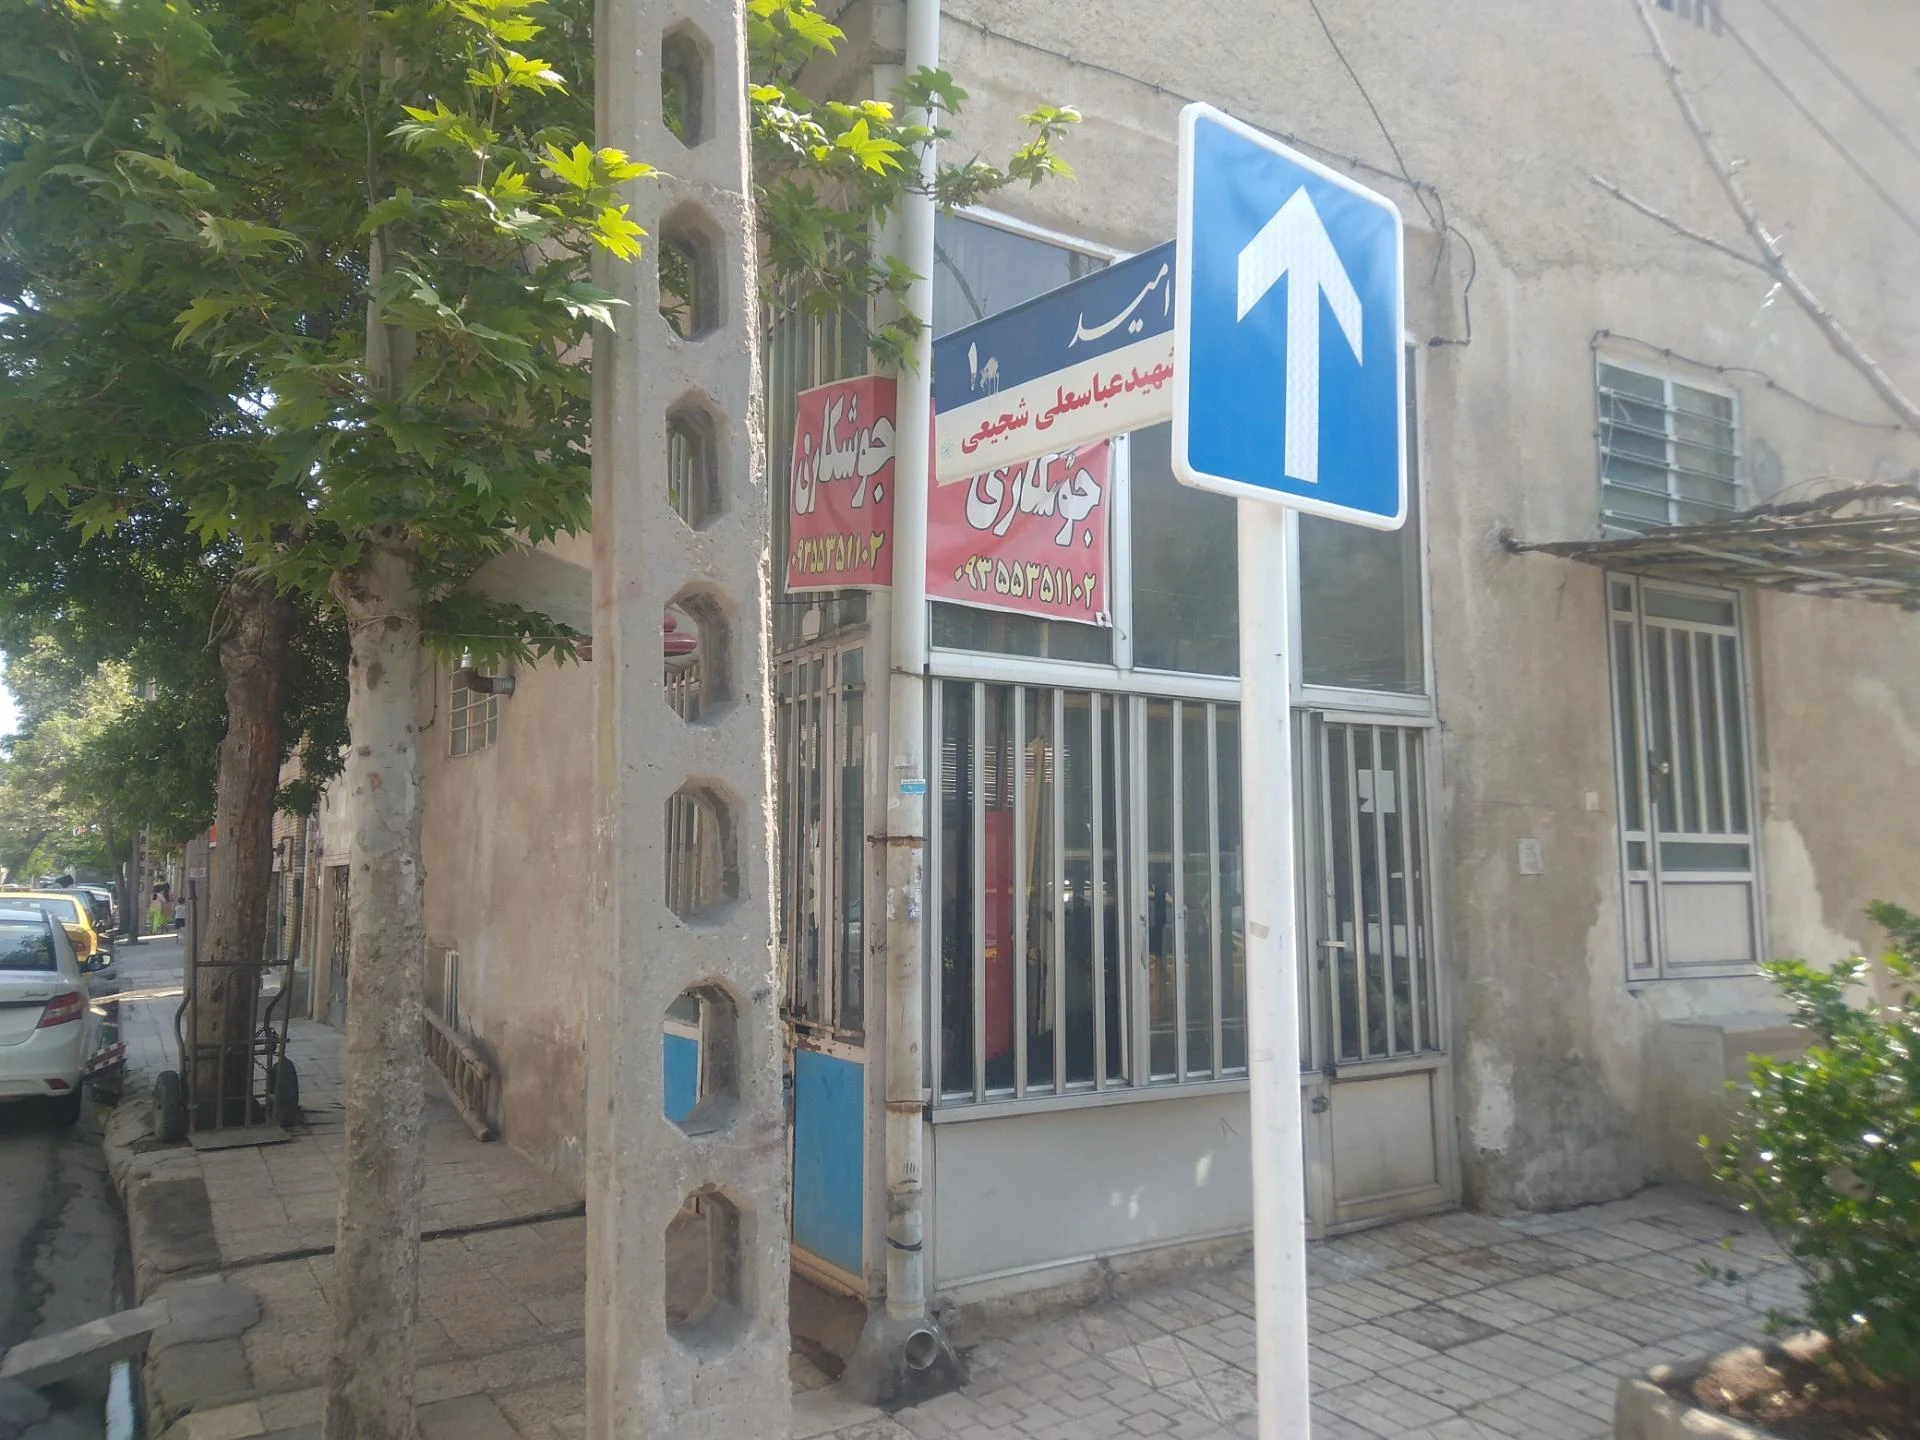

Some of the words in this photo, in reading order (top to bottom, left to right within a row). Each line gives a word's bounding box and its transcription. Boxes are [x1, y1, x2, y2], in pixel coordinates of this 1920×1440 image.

[1067, 262, 1171, 349] امید
[961, 397, 1029, 455] شجیعی
[965, 446, 1103, 548] جوشکاری
[954, 553, 1097, 610] ۰۹۳۵۵۳۵۱۱۰۲
